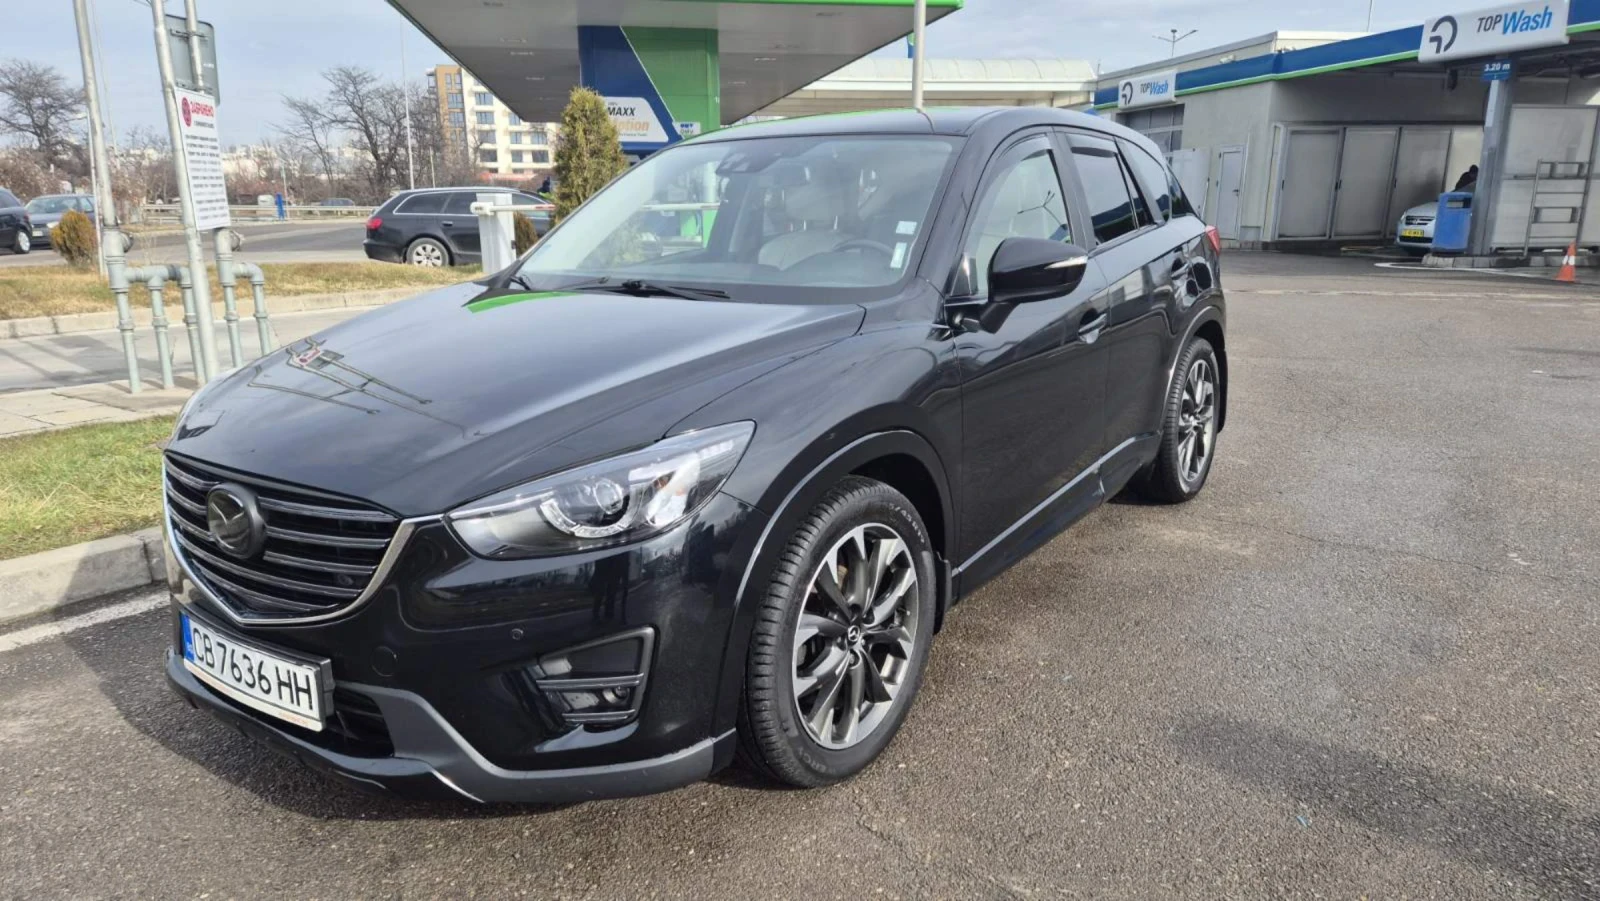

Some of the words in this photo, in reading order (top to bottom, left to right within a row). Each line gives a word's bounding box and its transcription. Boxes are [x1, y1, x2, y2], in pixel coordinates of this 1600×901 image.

[1477, 5, 1553, 35] TOPWash
[1140, 80, 1169, 96] TOPWash
[607, 106, 636, 117] MAXX
